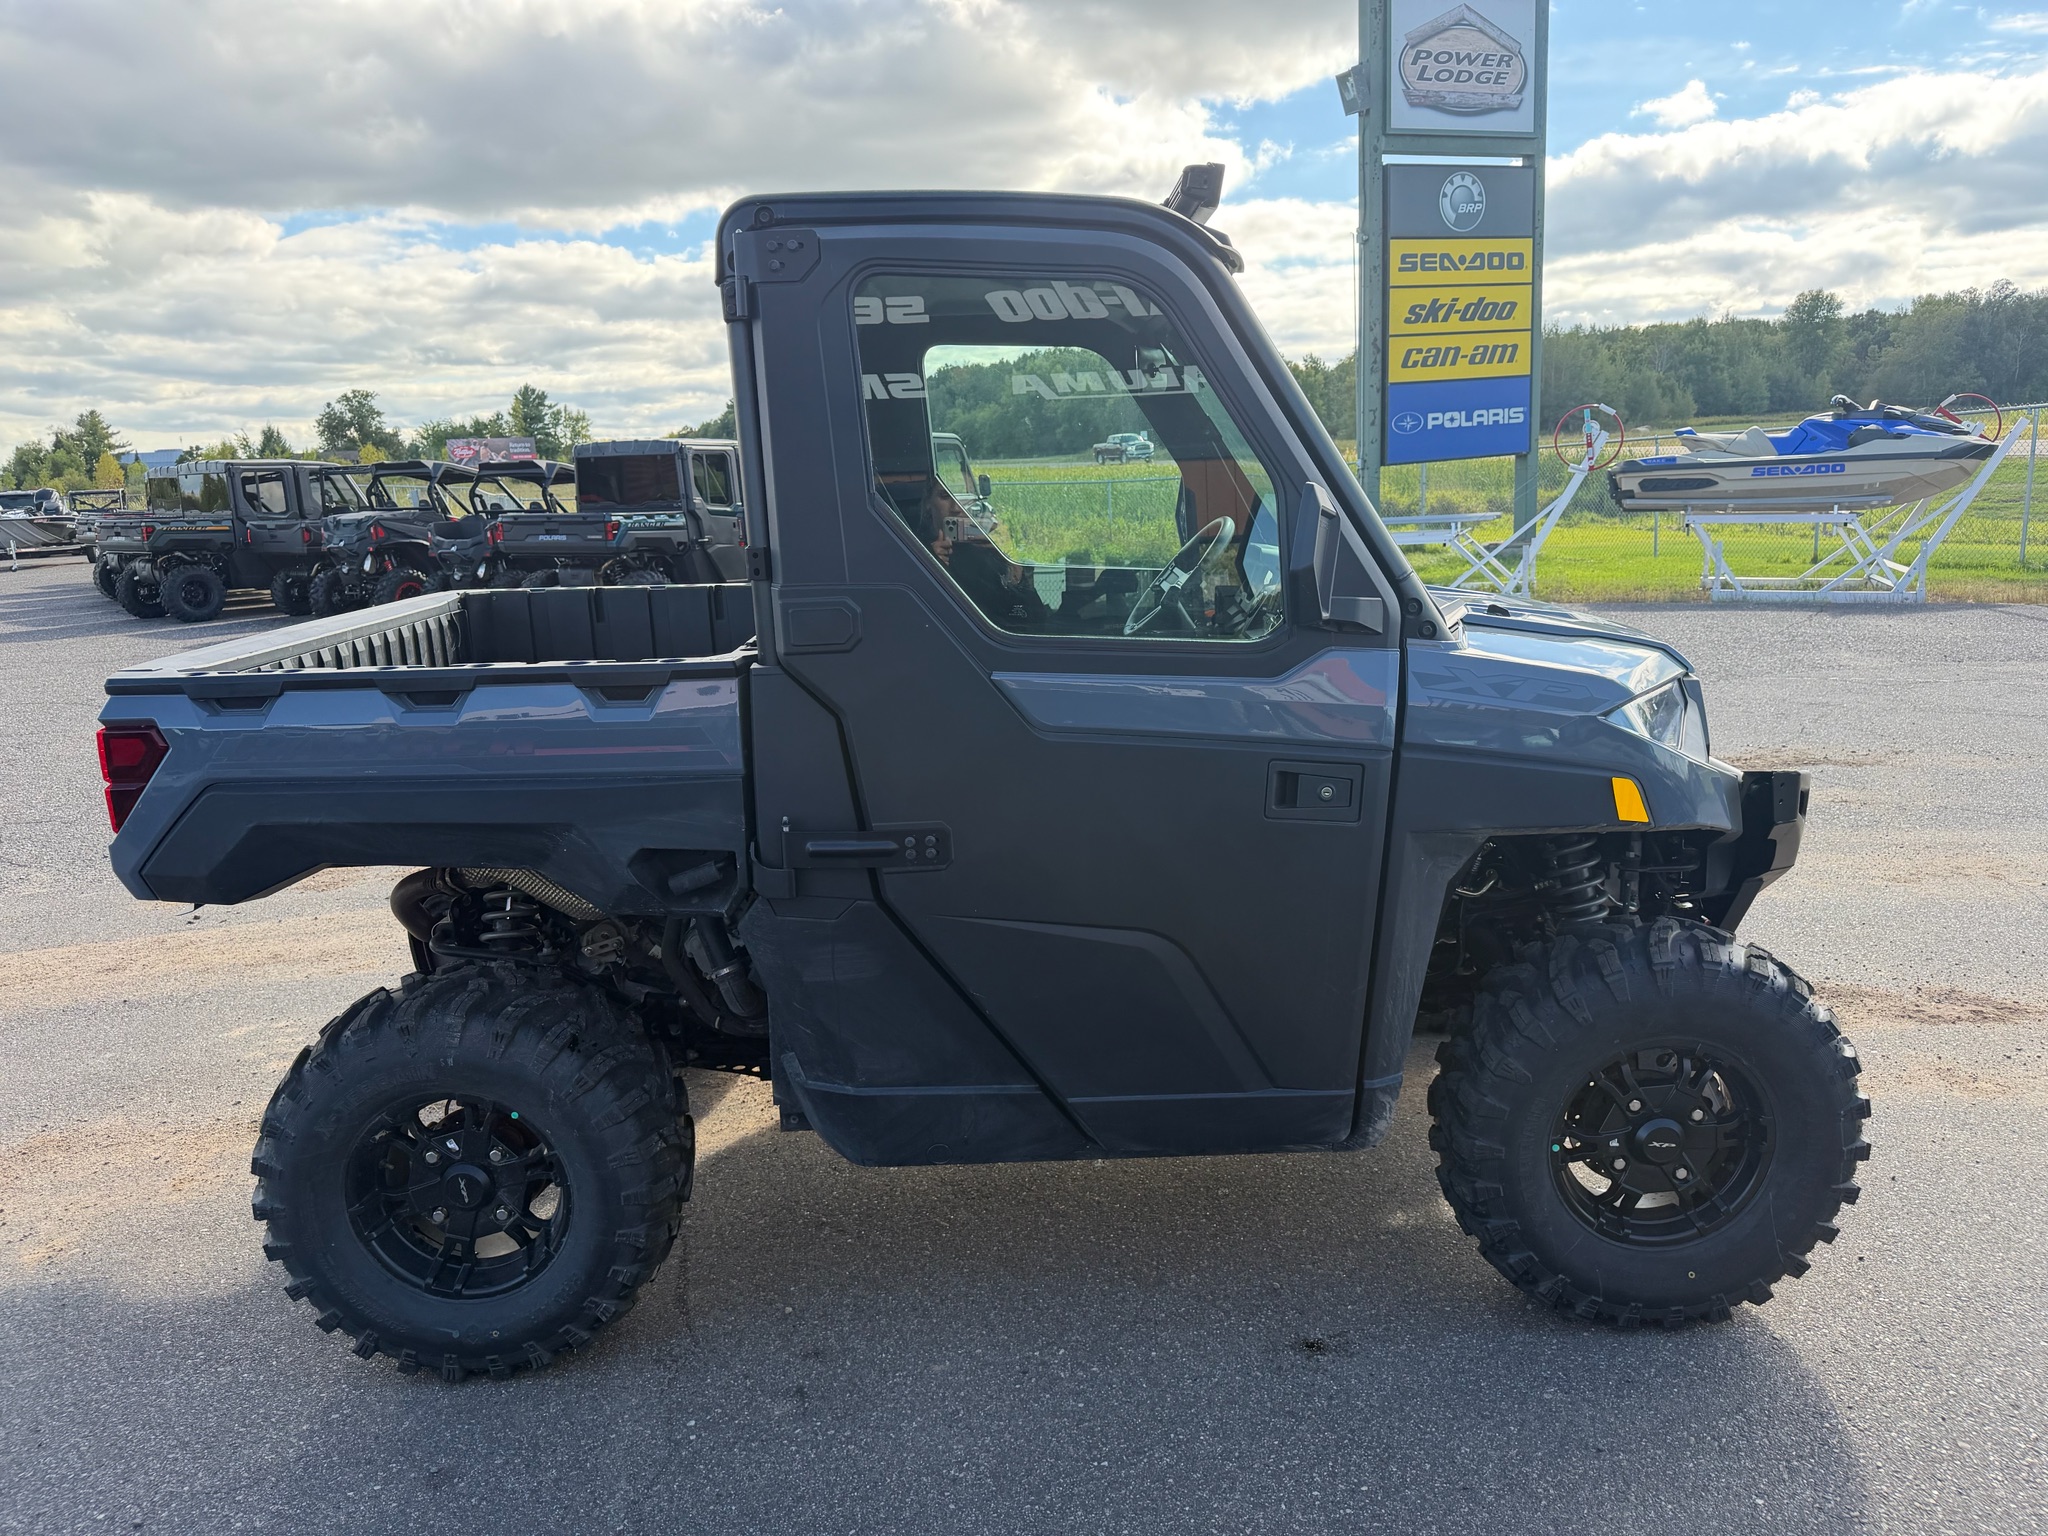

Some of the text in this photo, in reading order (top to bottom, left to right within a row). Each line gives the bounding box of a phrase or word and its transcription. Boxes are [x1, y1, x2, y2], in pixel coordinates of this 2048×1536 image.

[1410, 49, 1514, 68] POWER
[1416, 65, 1509, 86] LODGE
[1457, 203, 1483, 214] BRP
[1403, 297, 1518, 325] ski-doo
[1401, 342, 1518, 369] can-am
[1427, 407, 1525, 430] POLARIS
